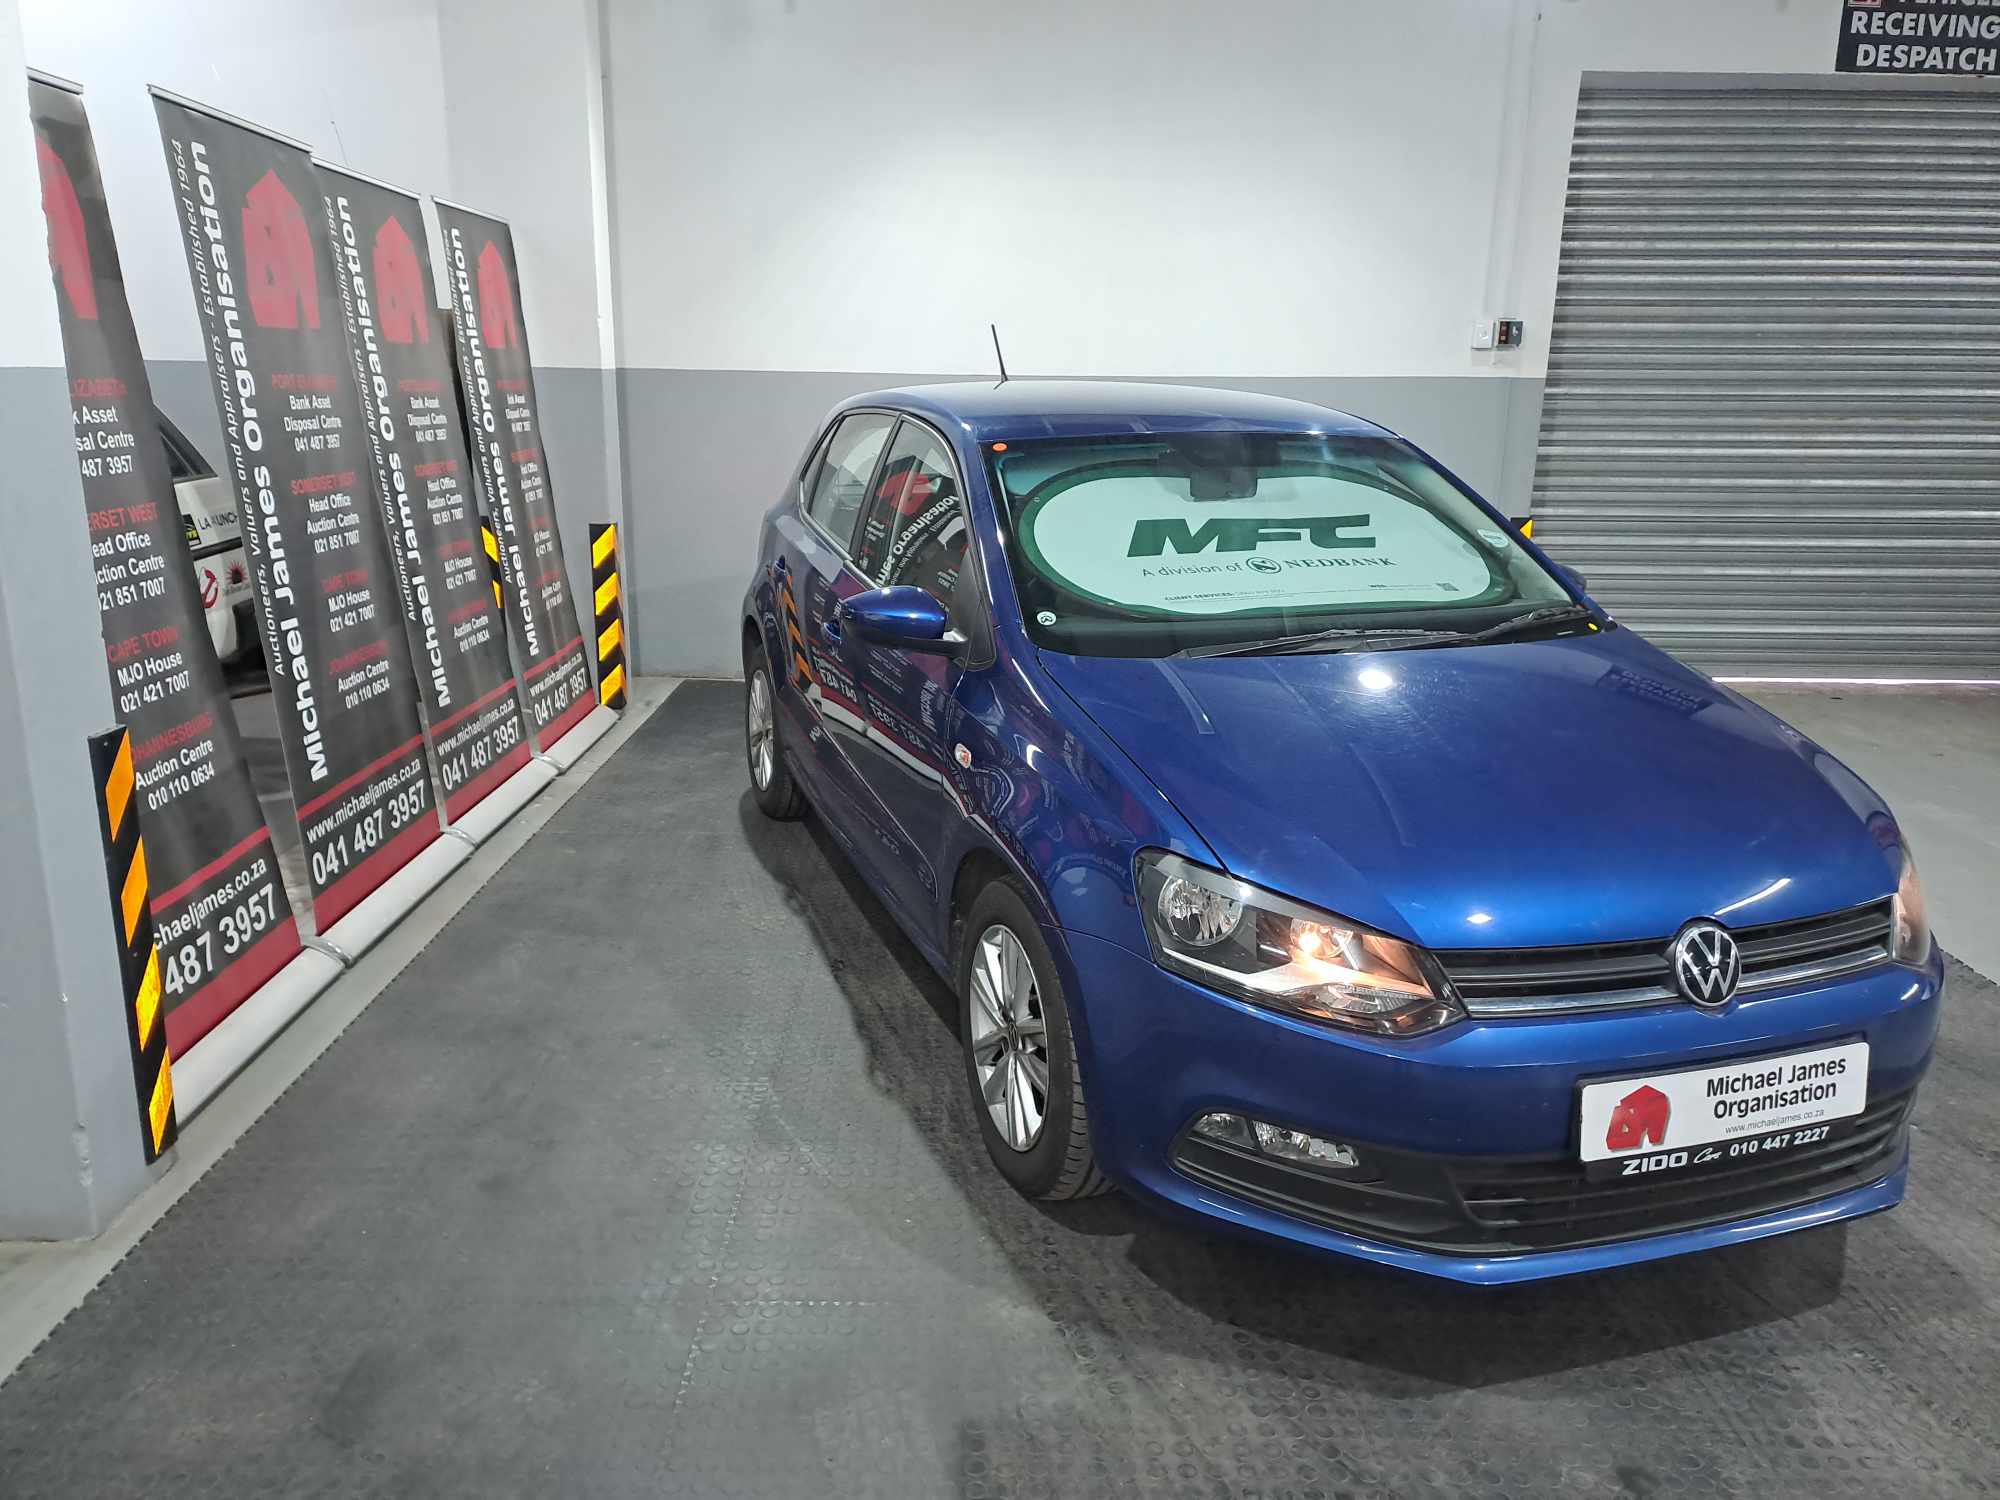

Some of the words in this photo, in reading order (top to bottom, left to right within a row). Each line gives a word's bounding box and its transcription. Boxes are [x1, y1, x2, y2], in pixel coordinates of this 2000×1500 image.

[1850, 11, 2000, 39] RECEIVING
[1856, 44, 1997, 71] DESPATCH
[171, 138, 191, 191] 1964
[182, 197, 215, 316] Established
[191, 141, 263, 452] Organisation
[212, 335, 239, 439] Appraisers
[289, 395, 310, 411] Bank
[82, 405, 118, 424] Asset
[284, 415, 319, 434] Disposal
[76, 432, 95, 451] sal
[97, 431, 134, 449] Centre
[370, 433, 383, 465] and
[82, 458, 102, 477] 487
[106, 455, 133, 475] 3957
[230, 443, 247, 481] and
[308, 496, 329, 512] Head
[389, 452, 421, 565] James
[490, 442, 516, 536] James
[241, 486, 261, 555] Valuers
[254, 465, 294, 605] James
[306, 517, 337, 535] Auction
[1127, 514, 1376, 557] MFC
[92, 537, 114, 557] ead
[115, 532, 151, 552] Office
[314, 537, 328, 553] 021
[128, 555, 165, 575] Centre
[1142, 567, 1155, 577] A
[1158, 564, 1221, 576] division
[1226, 562, 1243, 572] of
[1286, 557, 1398, 569] NEDBANK
[115, 584, 137, 606] 851
[140, 577, 165, 599] 7007
[508, 545, 540, 656] Michael
[329, 615, 343, 633] 021
[412, 575, 451, 707] Michael
[117, 662, 144, 687] MJO
[145, 652, 182, 676] House
[338, 671, 366, 693] Auction
[121, 691, 141, 713] 021
[143, 681, 164, 703] 421
[165, 671, 190, 694] 7007
[280, 617, 329, 782] Michael
[535, 695, 553, 725] 041
[555, 682, 568, 710] 487
[136, 757, 180, 790] Auction
[180, 740, 213, 766] Centre
[443, 753, 468, 791] 041
[471, 736, 491, 770] 487
[493, 716, 519, 753] 3957
[148, 786, 169, 810] 010
[169, 775, 190, 799] 110
[191, 761, 215, 786] 0634
[312, 835, 349, 885] 041
[354, 808, 383, 853] 487
[388, 779, 425, 829] 3957
[165, 931, 213, 995] 487
[219, 883, 276, 954] 3957
[1706, 1067, 1782, 1098] Michael
[1788, 1058, 1846, 1084] James
[1714, 1081, 1837, 1119] Organisation
[1724, 1109, 1825, 1134] www.michaeljames.co.za
[1622, 1151, 1688, 1176] ZIDO
[1729, 1141, 1758, 1158] 010
[1762, 1134, 1789, 1150] 447
[1793, 1126, 1830, 1145] 2227
